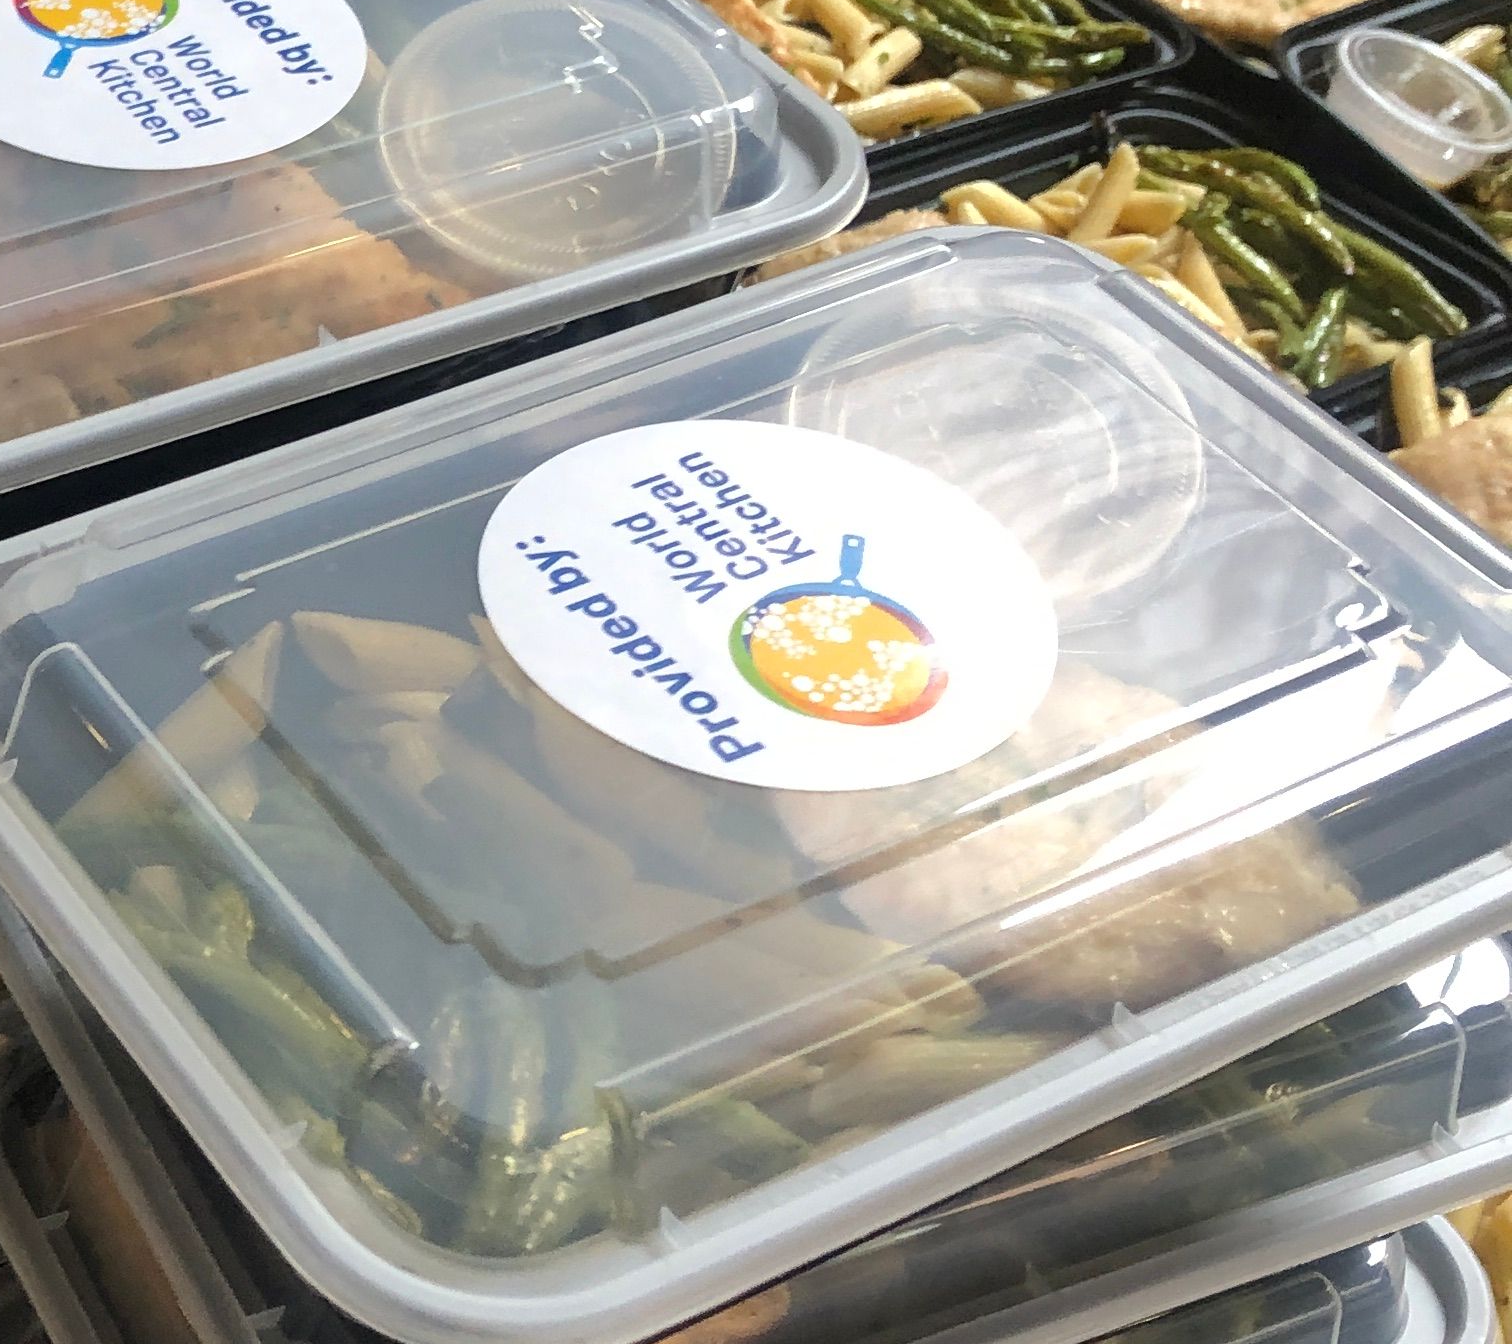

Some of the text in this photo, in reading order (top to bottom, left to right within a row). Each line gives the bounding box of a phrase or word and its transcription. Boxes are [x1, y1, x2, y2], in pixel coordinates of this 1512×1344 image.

[88, 58, 180, 144] Kitchen
[130, 49, 225, 128] Central
[167, 35, 248, 100] World
[277, 42, 332, 85] by:
[630, 474, 768, 581] Central
[678, 452, 816, 566] Kitchen
[611, 511, 728, 604] World
[515, 535, 765, 763] Provided by:
